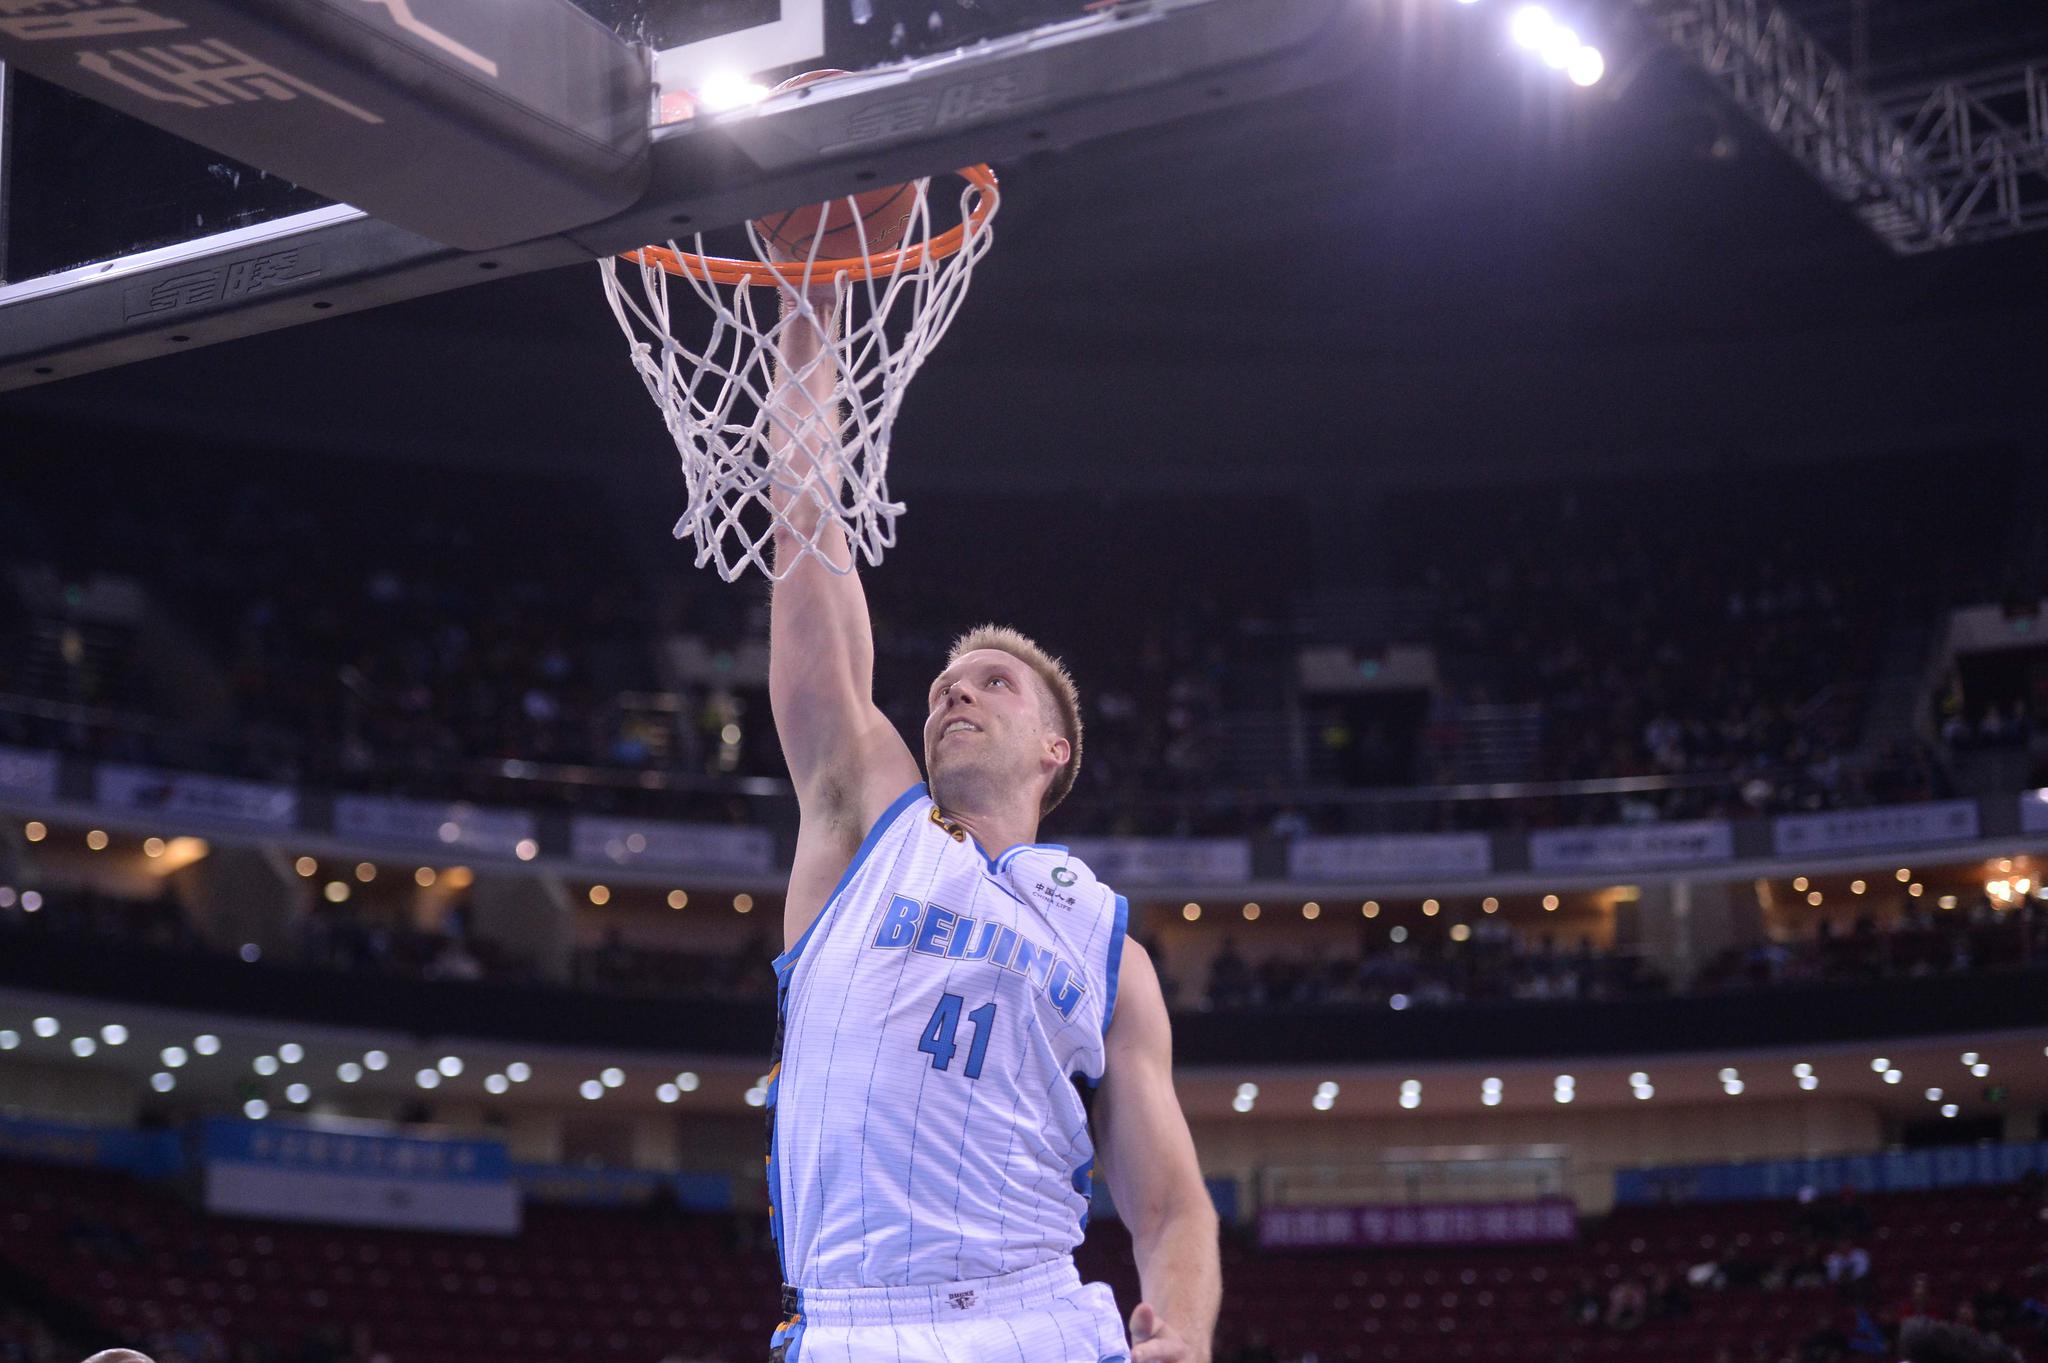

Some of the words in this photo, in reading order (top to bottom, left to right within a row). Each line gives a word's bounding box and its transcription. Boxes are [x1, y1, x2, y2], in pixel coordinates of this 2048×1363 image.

[1032, 891, 1054, 904] CHINA
[1056, 902, 1073, 912] LIFE
[1036, 883, 1076, 905] 中国人寿
[871, 894, 1088, 1022] BEIJING
[918, 993, 996, 1079] 41
